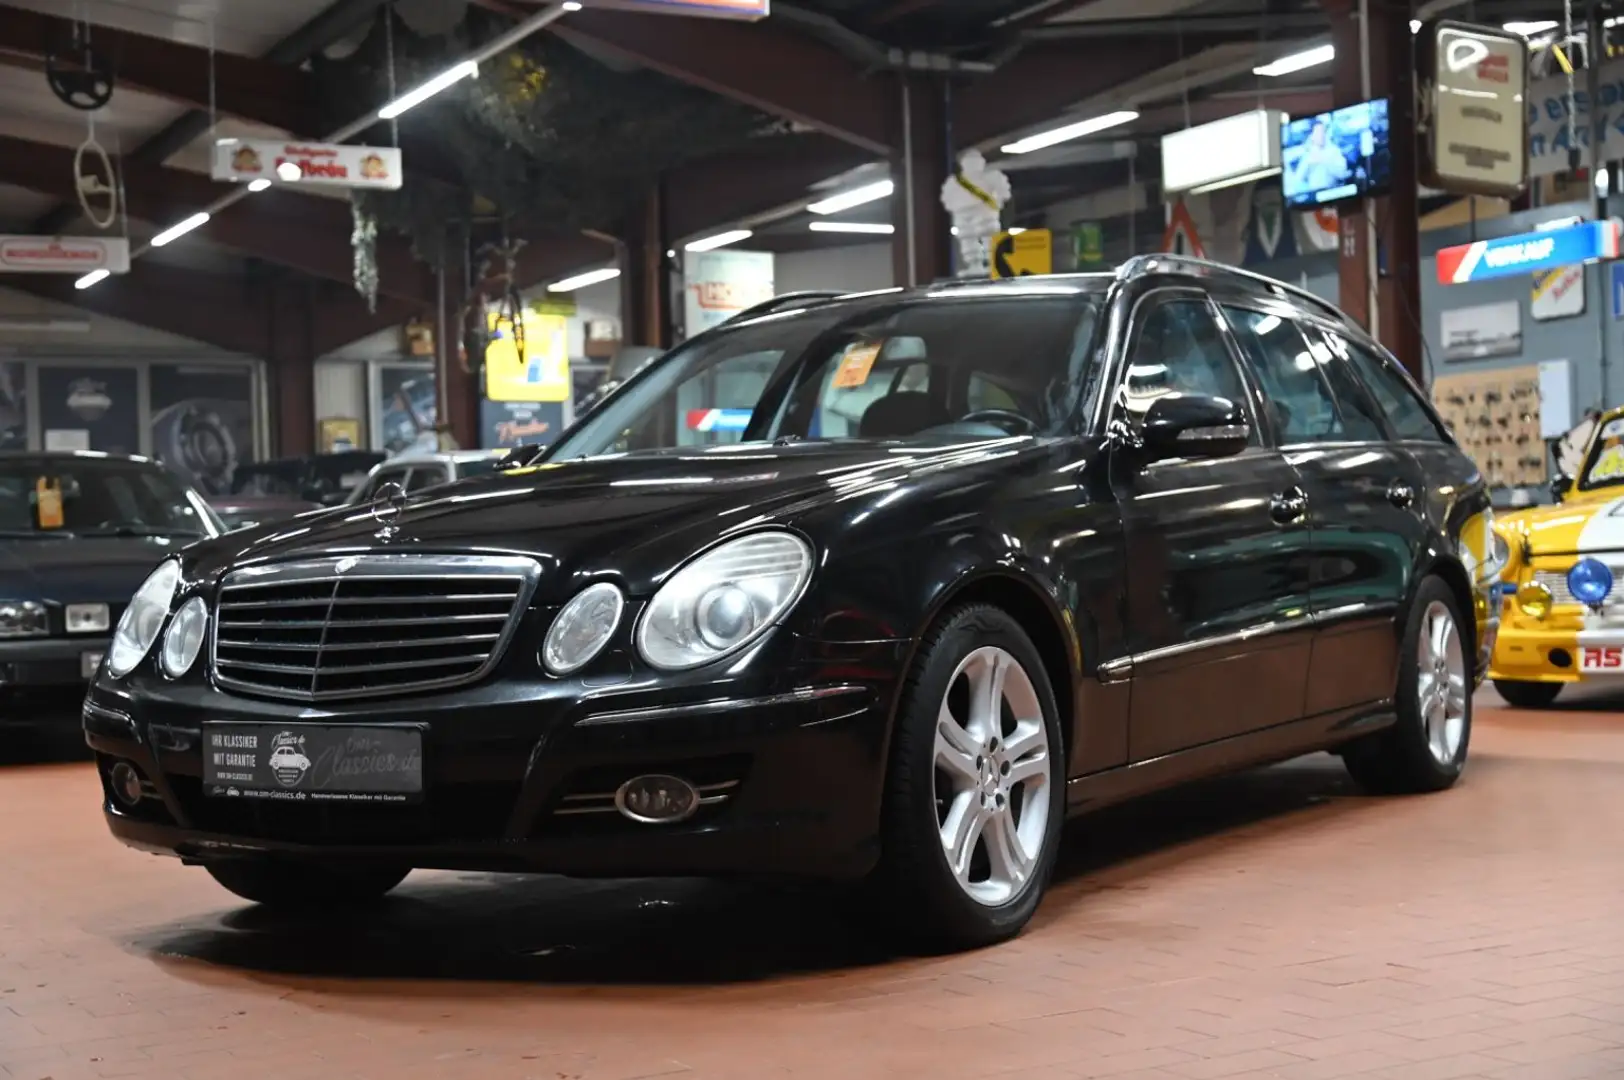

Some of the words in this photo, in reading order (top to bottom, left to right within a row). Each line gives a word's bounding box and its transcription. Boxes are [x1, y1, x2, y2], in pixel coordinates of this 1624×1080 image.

[211, 734, 223, 747] IHR
[224, 735, 258, 748] KLASSIKER
[213, 752, 225, 766] MIT
[226, 753, 256, 768] GARANTIE
